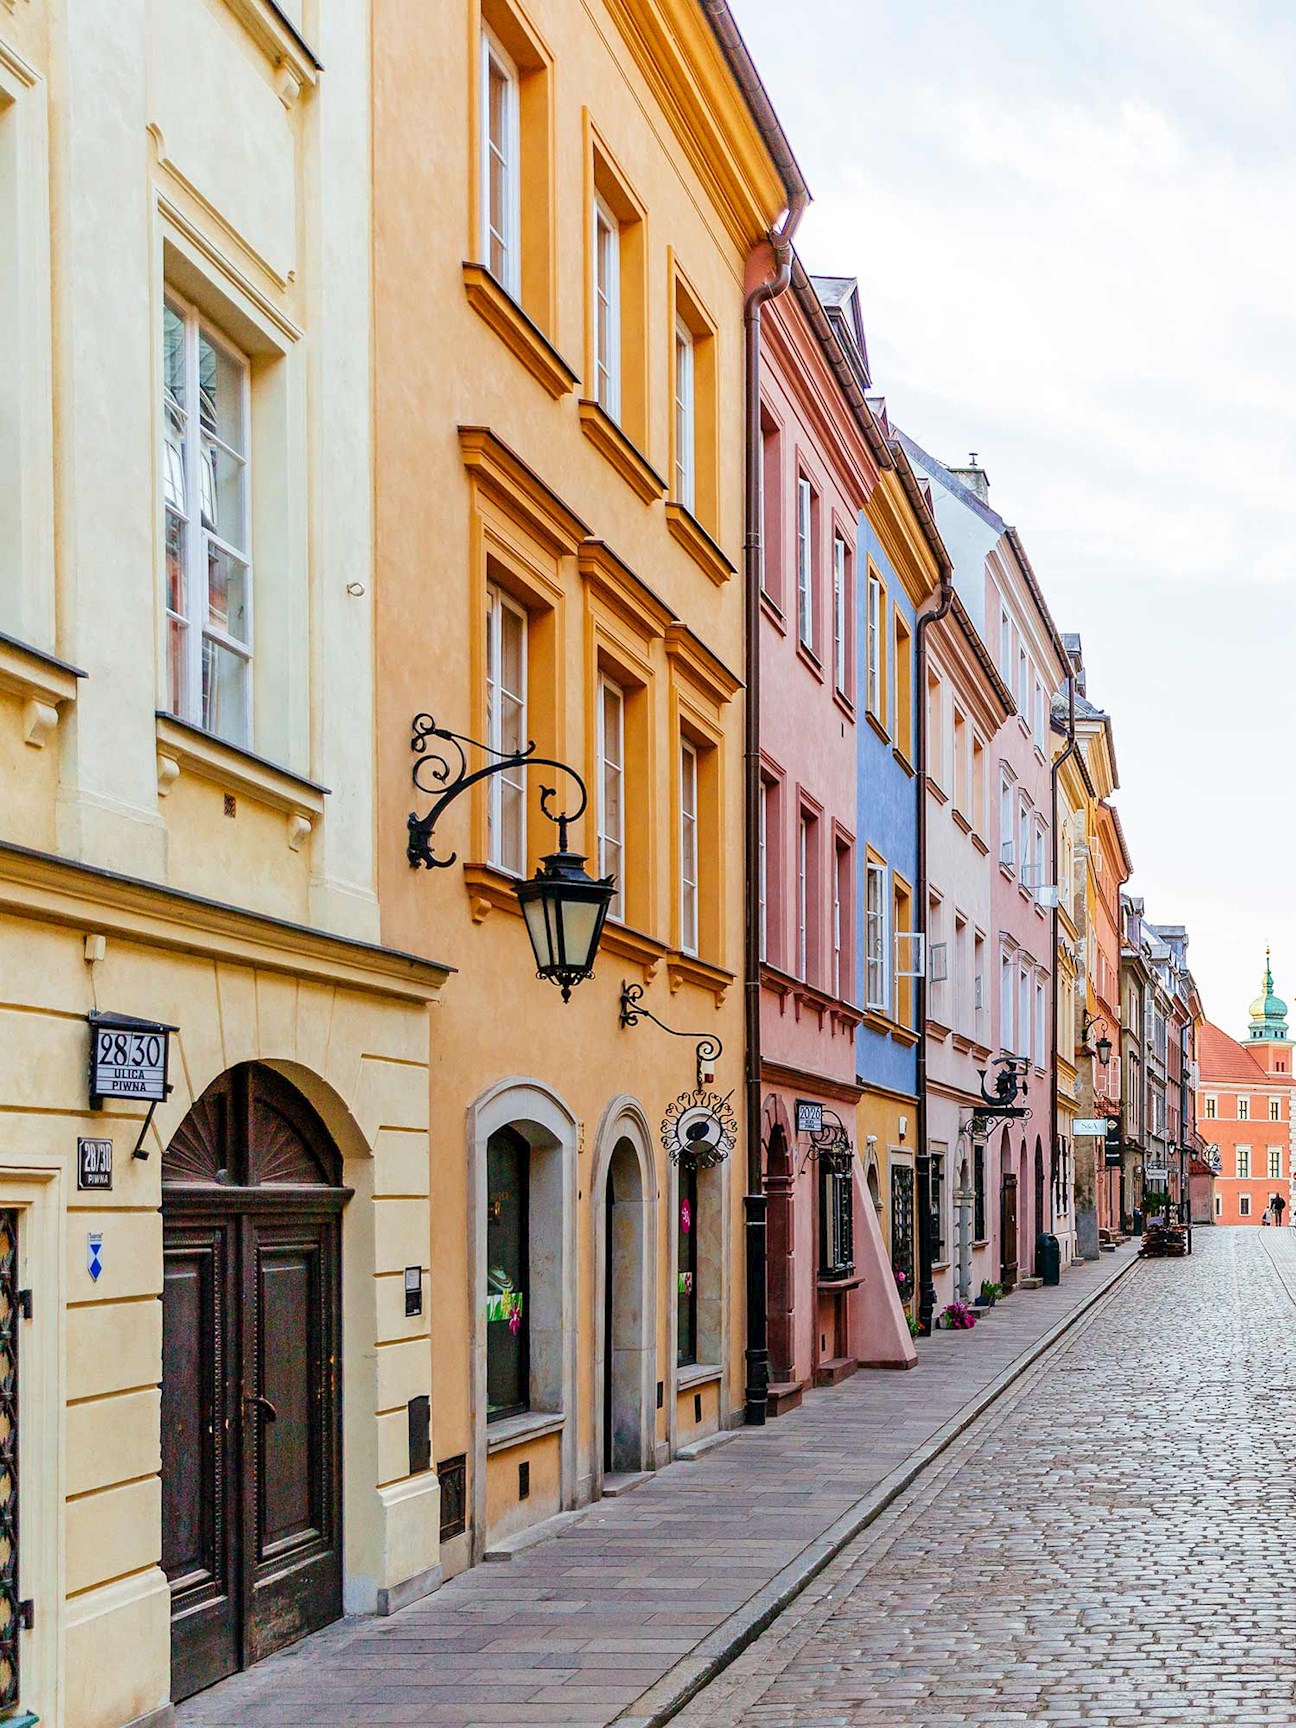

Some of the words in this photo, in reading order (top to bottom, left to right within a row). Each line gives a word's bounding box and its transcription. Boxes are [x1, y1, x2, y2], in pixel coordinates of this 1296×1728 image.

[114, 1069, 145, 1079] ULICA
[112, 1081, 147, 1092] PIWNA
[84, 1143, 111, 1173] 28/30
[87, 1174, 109, 1184] PIWNA
